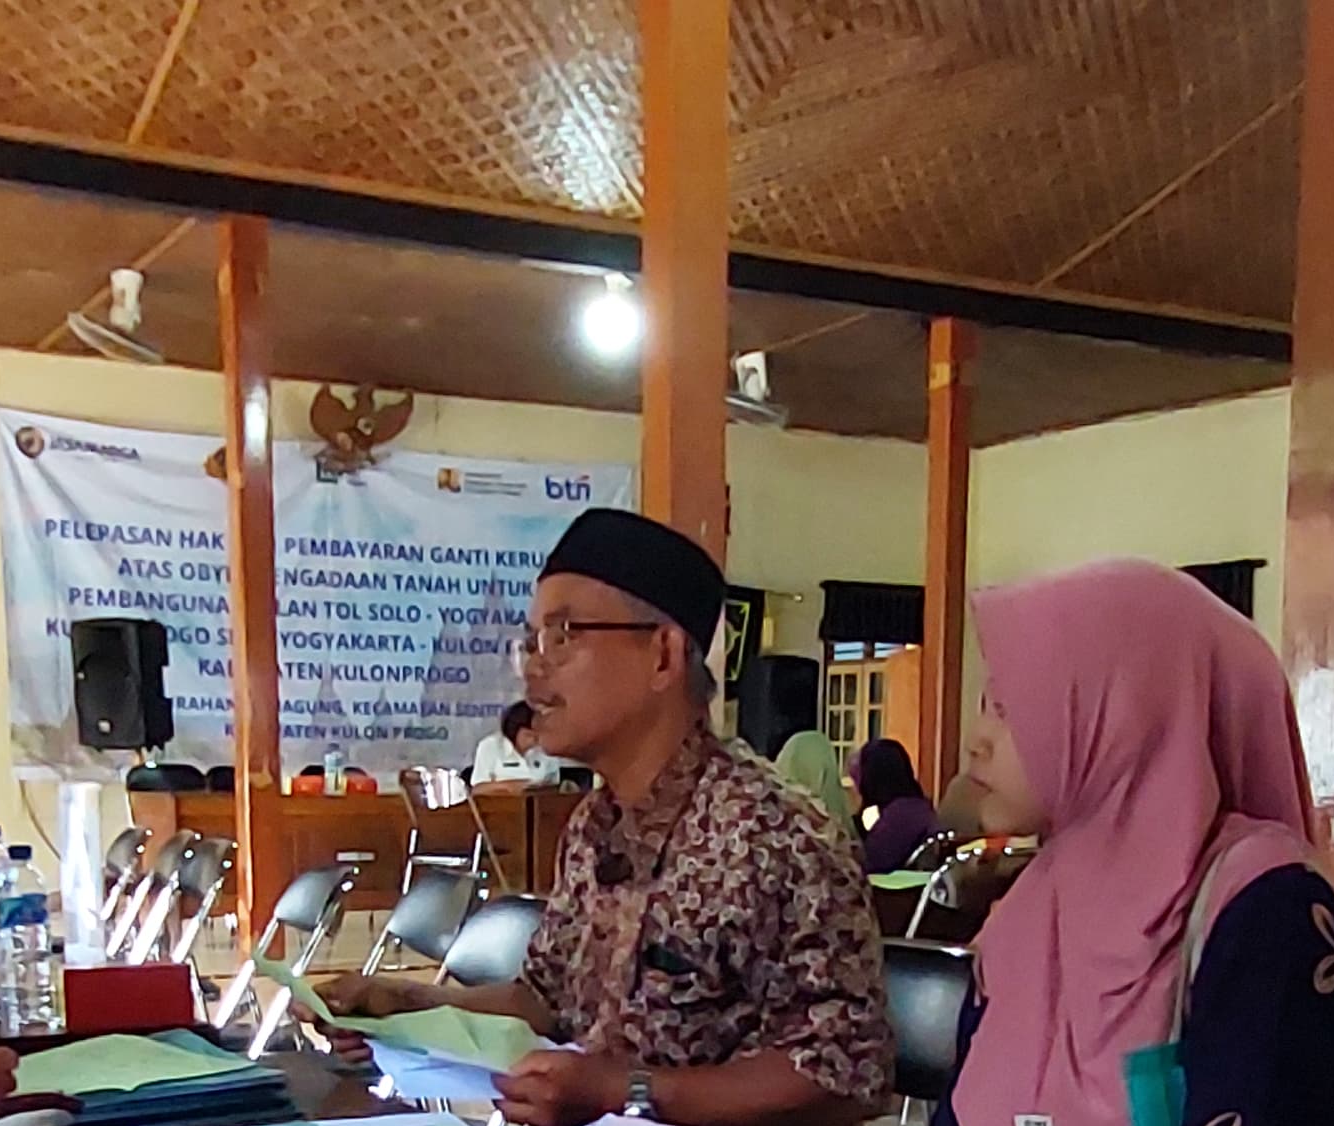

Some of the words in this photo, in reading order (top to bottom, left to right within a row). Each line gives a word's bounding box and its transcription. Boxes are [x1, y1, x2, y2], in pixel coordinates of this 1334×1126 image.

[545, 475, 591, 500] btn
[45, 519, 172, 547] PELEPASAN
[179, 530, 226, 551] HAK
[285, 537, 424, 563] PEMBAYARAN
[430, 546, 490, 565] GANTI
[495, 551, 547, 569] KERU
[118, 558, 173, 580] ATAS
[179, 562, 231, 584] OBY
[394, 574, 461, 595] TANAH
[467, 579, 533, 599] UNTUK
[68, 587, 230, 614] PEMBANGUNA
[323, 601, 362, 621] TOL
[368, 604, 422, 624] SOLO
[438, 607, 528, 627] YOGYAKA
[166, 626, 210, 645] OGO
[280, 631, 415, 653] YOGYAKARTA
[432, 636, 500, 656] KULON
[331, 663, 471, 684] KULONPROGO
[353, 700, 451, 717] KECAMATAN
[331, 725, 388, 741] KULON
[392, 726, 450, 741] PROGO
